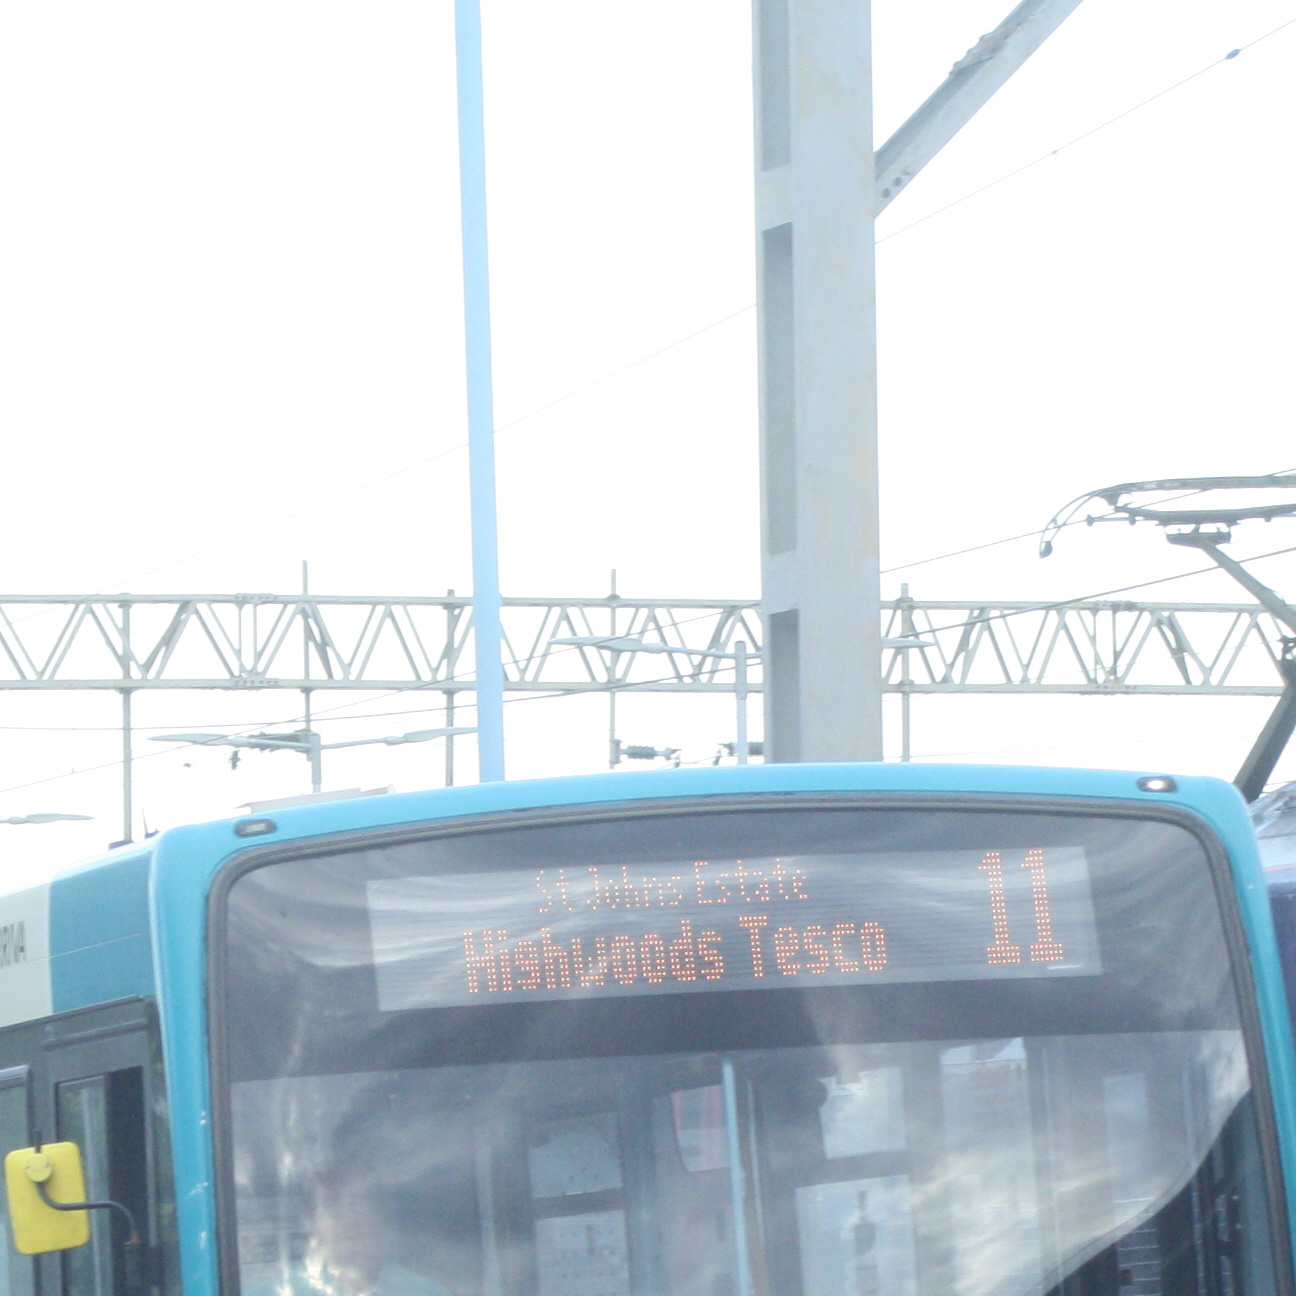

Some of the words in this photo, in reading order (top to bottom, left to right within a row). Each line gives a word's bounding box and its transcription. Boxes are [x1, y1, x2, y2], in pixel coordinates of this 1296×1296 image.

[694, 857, 808, 904] Estate
[978, 849, 1064, 963] 11
[462, 918, 724, 993] Highwoods
[738, 914, 888, 977] Tesco
